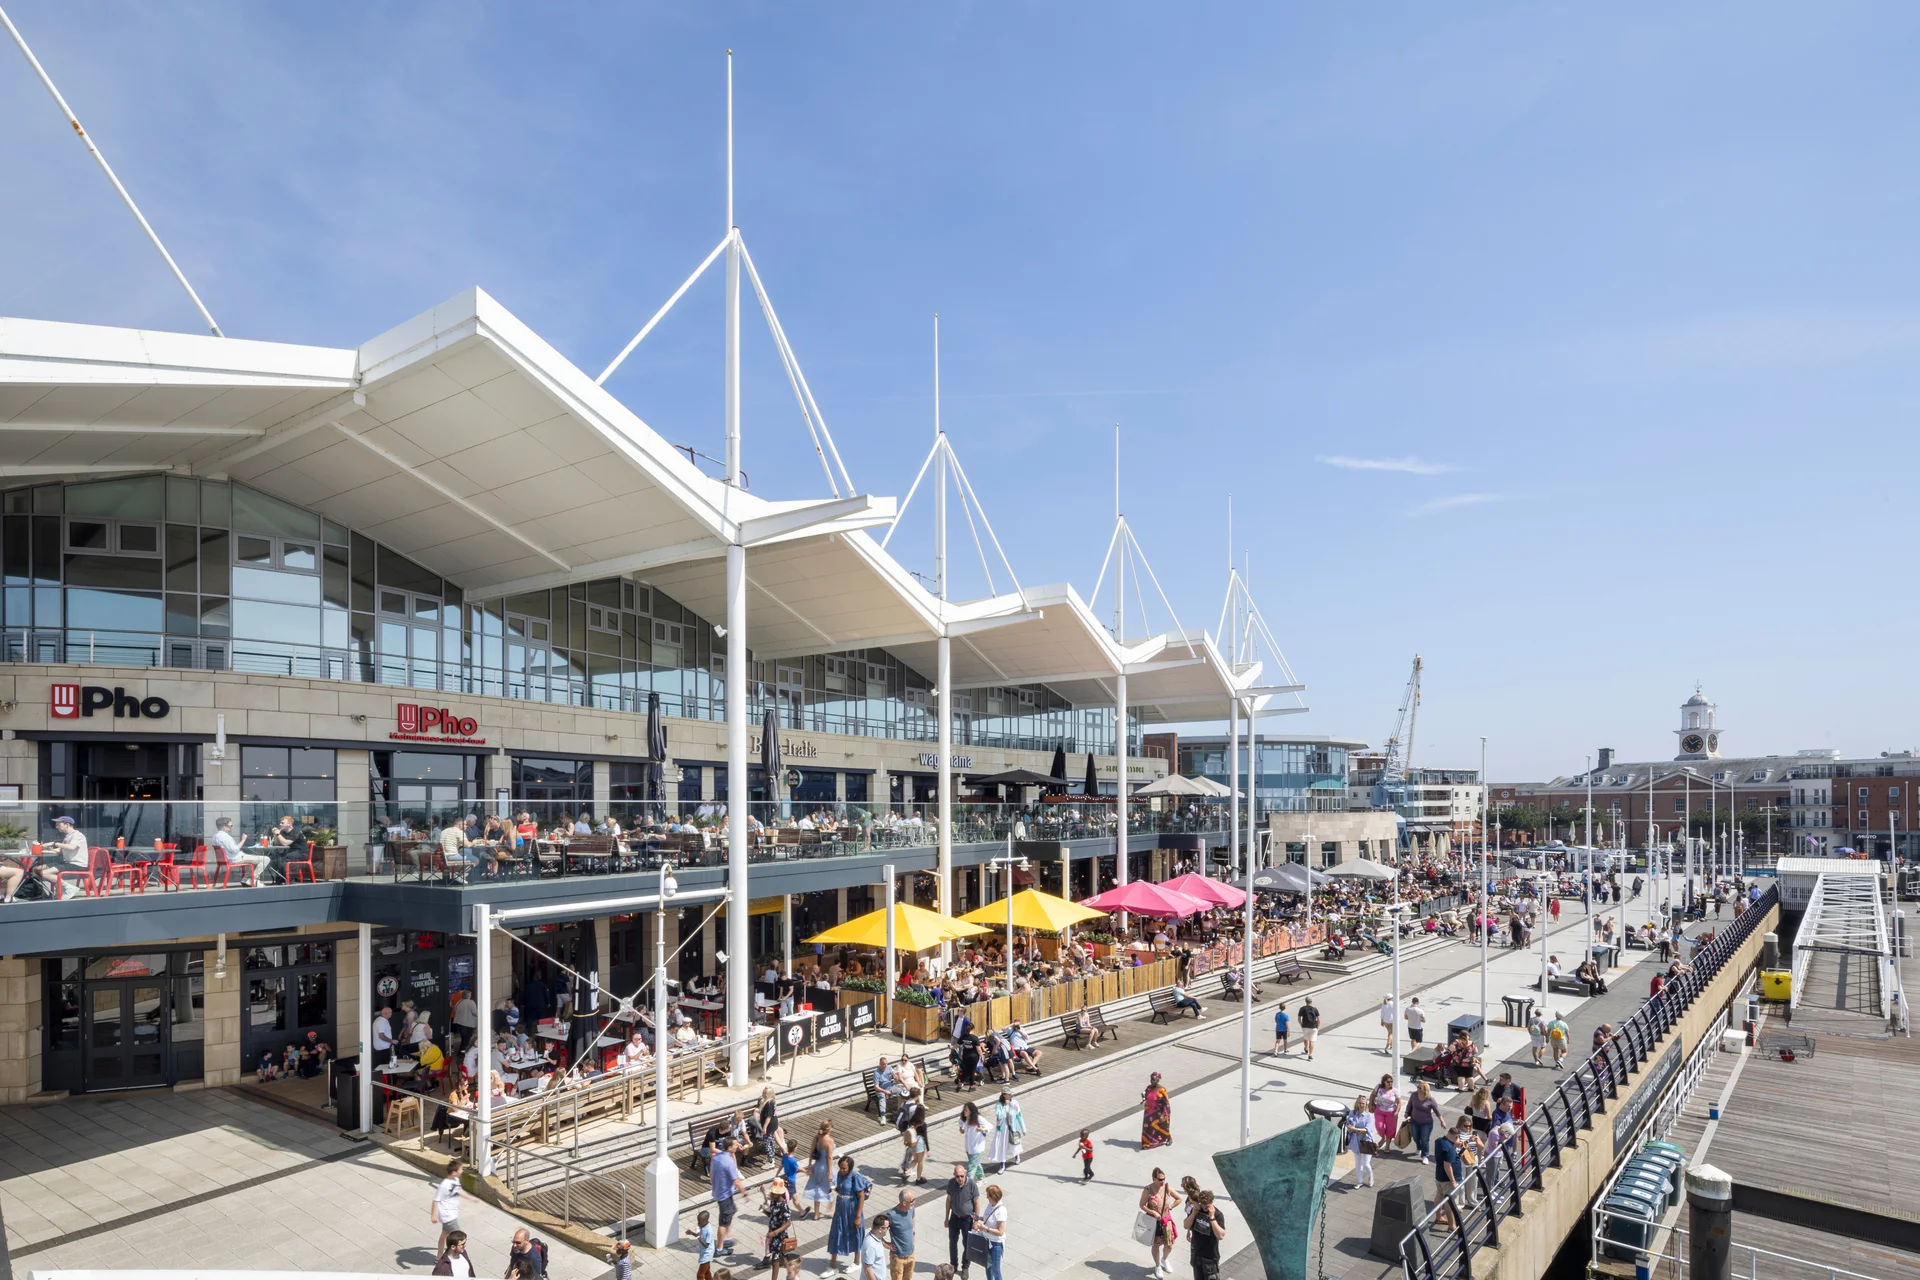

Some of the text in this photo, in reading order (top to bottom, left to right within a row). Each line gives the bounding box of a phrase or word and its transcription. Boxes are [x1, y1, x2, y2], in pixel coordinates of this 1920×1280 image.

[82, 686, 170, 719] Pho
[419, 706, 478, 736] Pho
[389, 732, 487, 746] Vietnamese street food
[786, 739, 819, 758] Italia
[857, 1005, 868, 1016] SLIM
[825, 1014, 837, 1026] SLIM
[820, 1022, 841, 1037] CHICKENS
